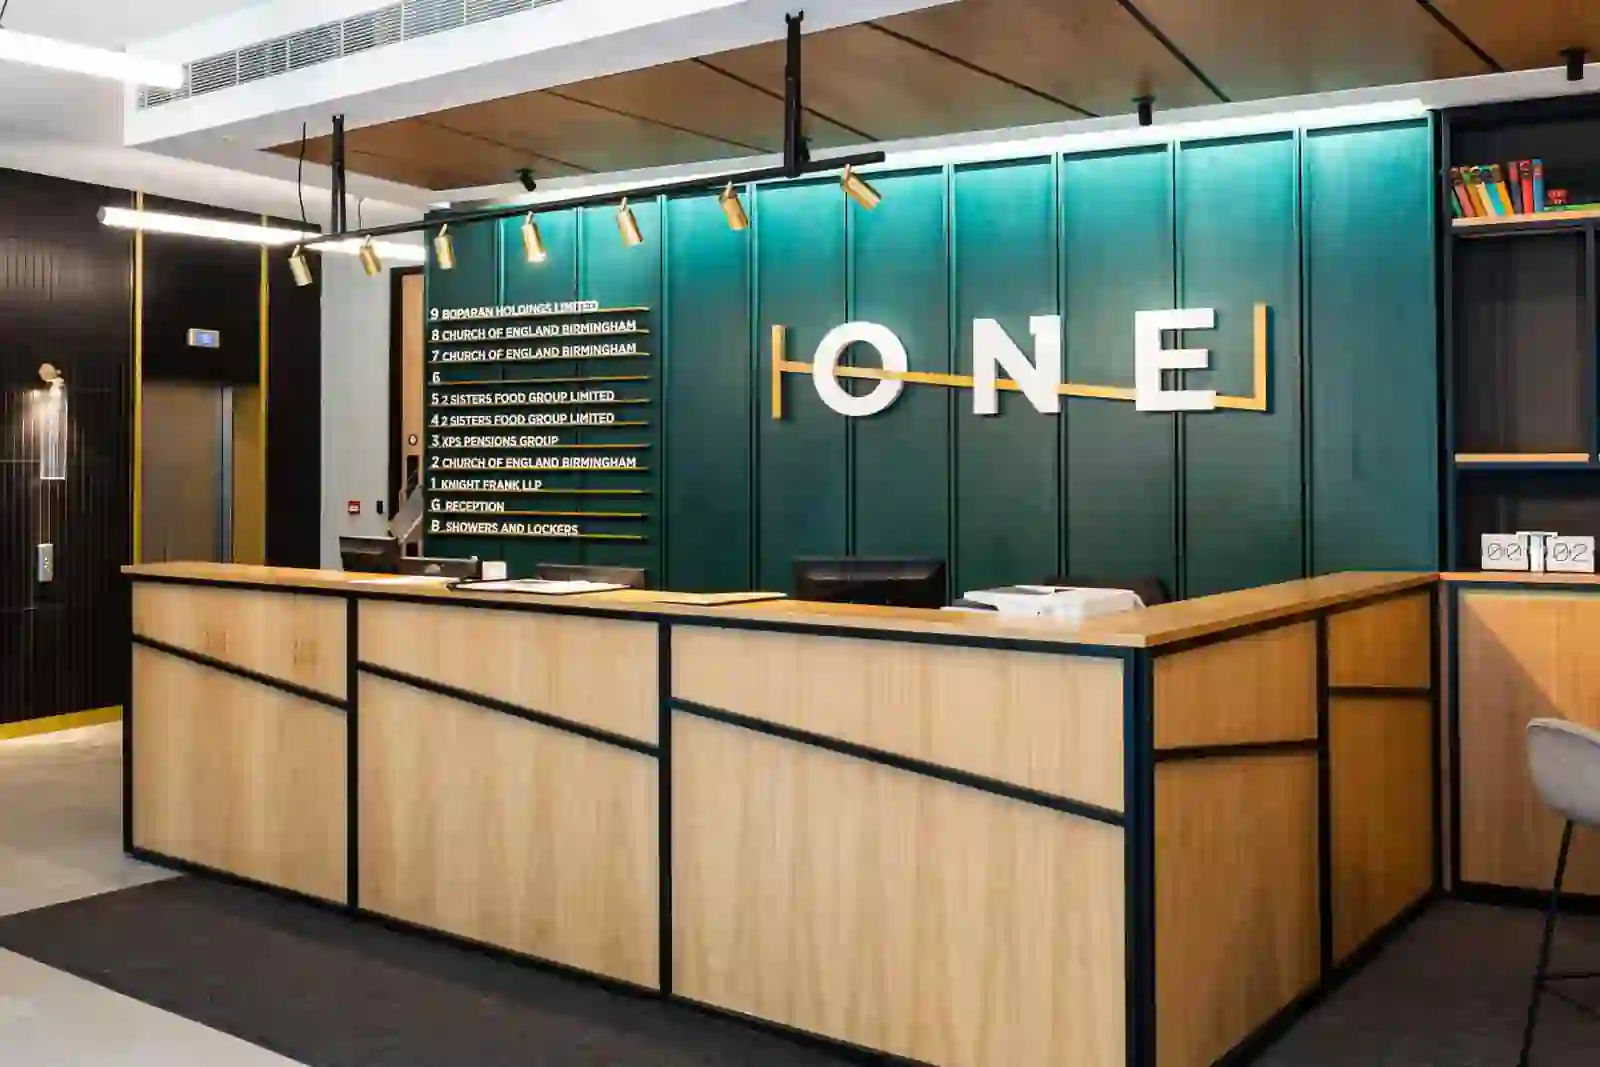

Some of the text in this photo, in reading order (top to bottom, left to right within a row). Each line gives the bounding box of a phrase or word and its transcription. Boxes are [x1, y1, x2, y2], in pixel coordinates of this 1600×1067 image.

[431, 301, 598, 320] 9 BOPARAN HOLDINGS LIMITED
[431, 320, 637, 341] 8 CHURCH OF ENGLAND BIRMINGHAM
[431, 343, 637, 362] 7 CHURCH OF ENGLAND BIRMINGHAM
[813, 308, 1216, 417] ONE
[432, 372, 441, 383] 6
[431, 390, 615, 405] 5 2 SISTERS FOOD GROUP LIMITED
[431, 412, 615, 426] 4 2 SISTERS FOOD GROUP LIMITED
[431, 434, 560, 447] 3 XPS PENSIONS GROUP
[431, 456, 637, 468] 2 CHURCH OF ENGLAND BIRMINGHAM
[430, 477, 542, 491] 1 KNIGHT FRANK LLP
[431, 499, 505, 513] G RECEPTION
[431, 520, 580, 536] B SHOWERS AND LOCKERS
